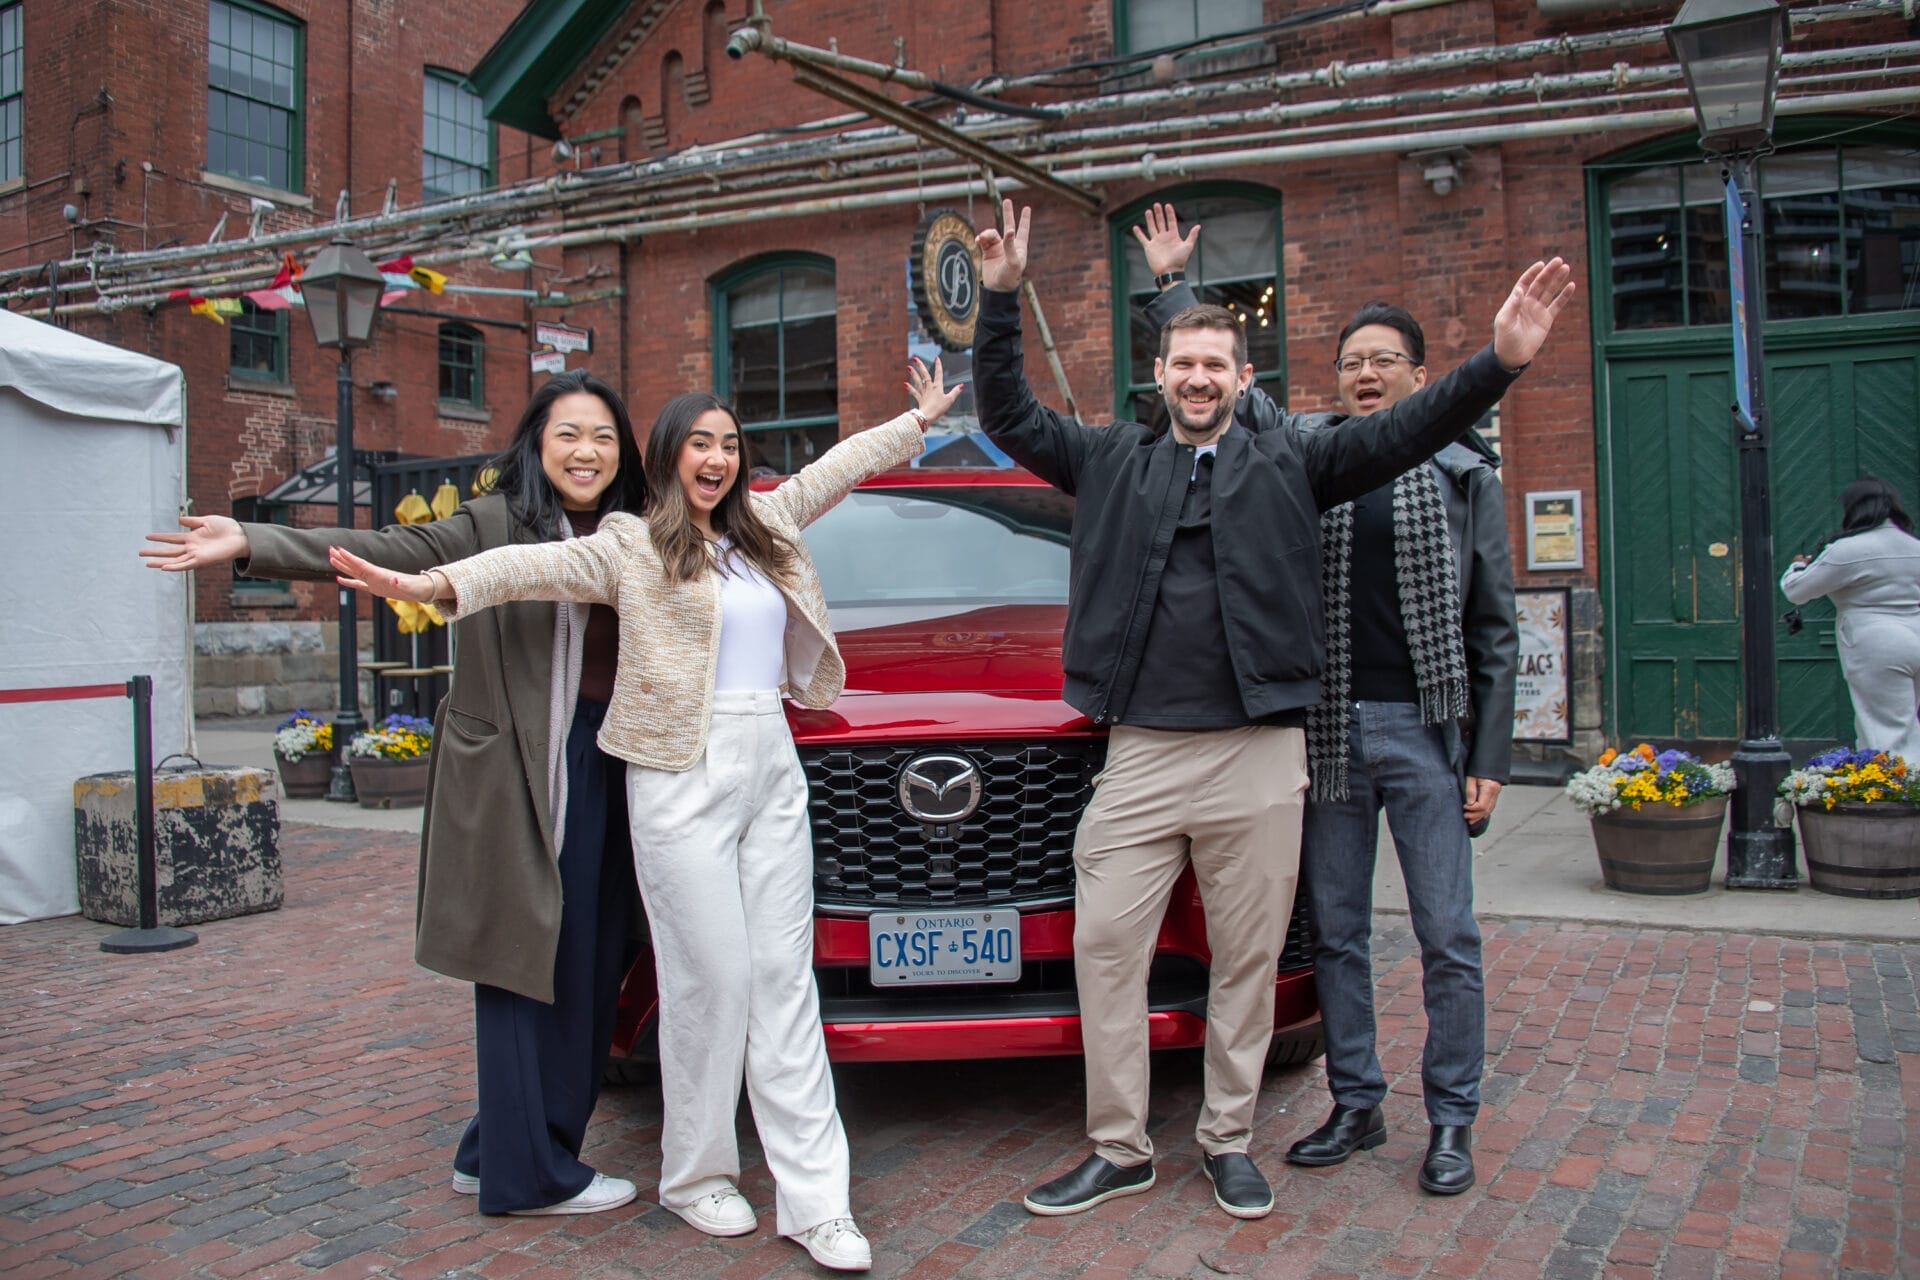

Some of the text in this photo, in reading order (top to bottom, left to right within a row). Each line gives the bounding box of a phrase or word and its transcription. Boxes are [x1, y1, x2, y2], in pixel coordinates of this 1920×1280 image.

[1517, 654, 1553, 676] ZACS
[916, 917, 974, 930] ONTARIO
[876, 929, 1012, 967] CXSF 540
